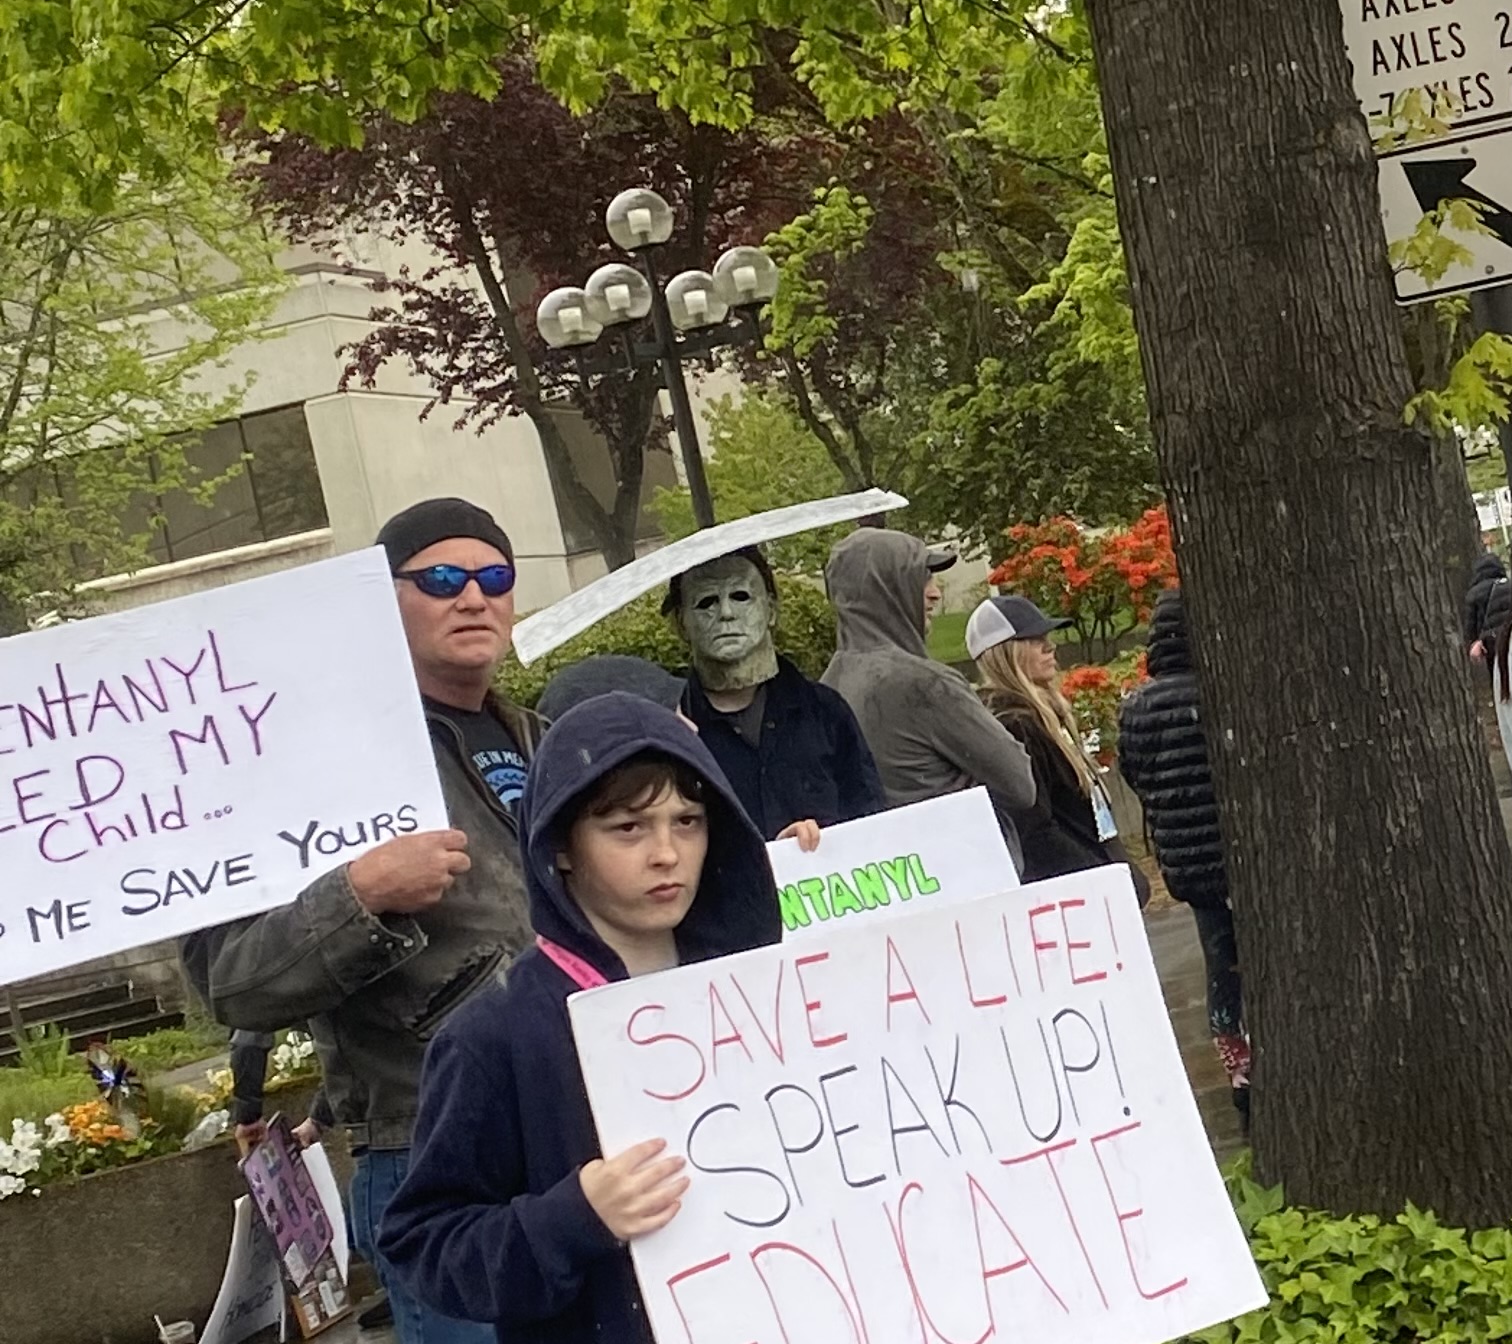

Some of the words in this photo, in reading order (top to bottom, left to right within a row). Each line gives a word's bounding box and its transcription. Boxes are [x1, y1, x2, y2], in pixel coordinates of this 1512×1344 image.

[1372, 22, 1466, 76] AXLES
[1412, 72, 1494, 118] XLES
[0, 754, 125, 834] ED
[169, 692, 277, 774] MY
[26, 899, 91, 943] ME
[120, 853, 257, 916] SAVE
[626, 952, 848, 1101] SAVE
[886, 935, 932, 1033] A
[954, 895, 1125, 1009] LIFE!
[685, 1033, 994, 1229] SPEAK
[1000, 1000, 1133, 1144] UP!
